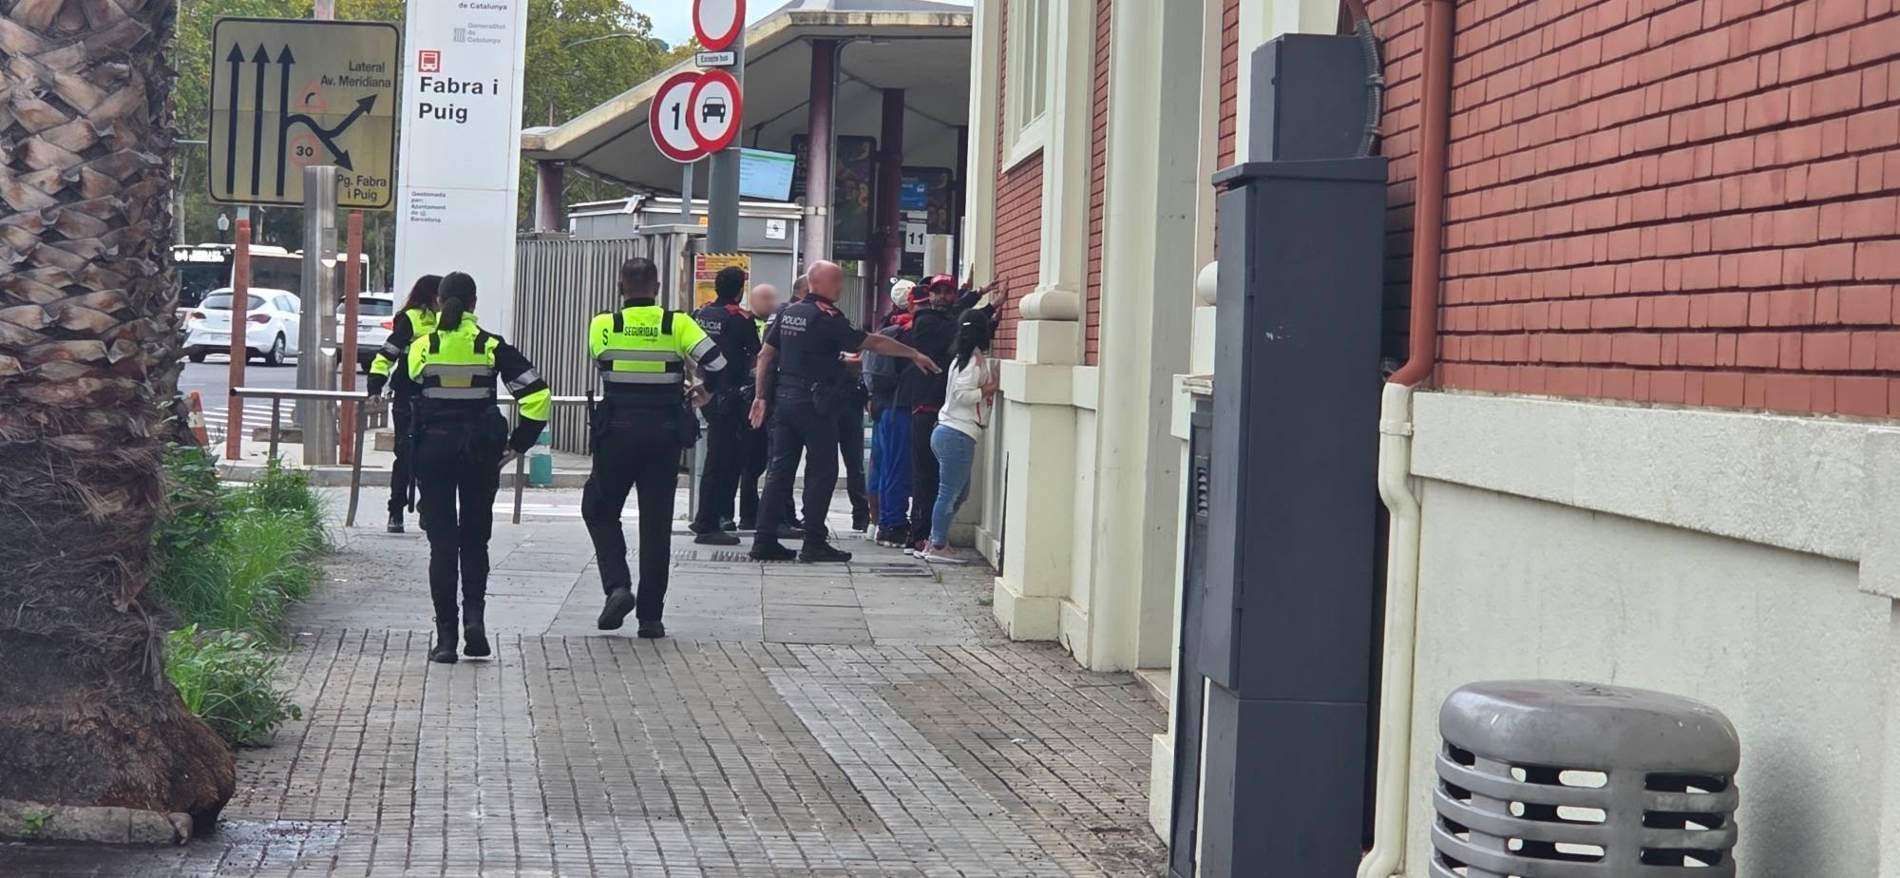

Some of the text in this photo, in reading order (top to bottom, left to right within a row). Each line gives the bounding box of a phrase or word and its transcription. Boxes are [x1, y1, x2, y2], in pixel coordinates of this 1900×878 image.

[470, 2, 507, 11] Catalunya
[348, 60, 385, 72] Lateral
[321, 74, 391, 88] Av. Meridiana
[420, 76, 498, 95] Fabra i
[419, 102, 468, 124] Puig
[671, 102, 681, 131] 1
[296, 145, 314, 157] 30
[337, 174, 386, 187] Pg. Fabra
[347, 188, 378, 202] i Puig
[909, 232, 924, 245] 11
[697, 319, 722, 331] OLICIA
[782, 315, 807, 327] POLICIA
[602, 328, 609, 346] S
[624, 326, 658, 337] SEGURIDAD
